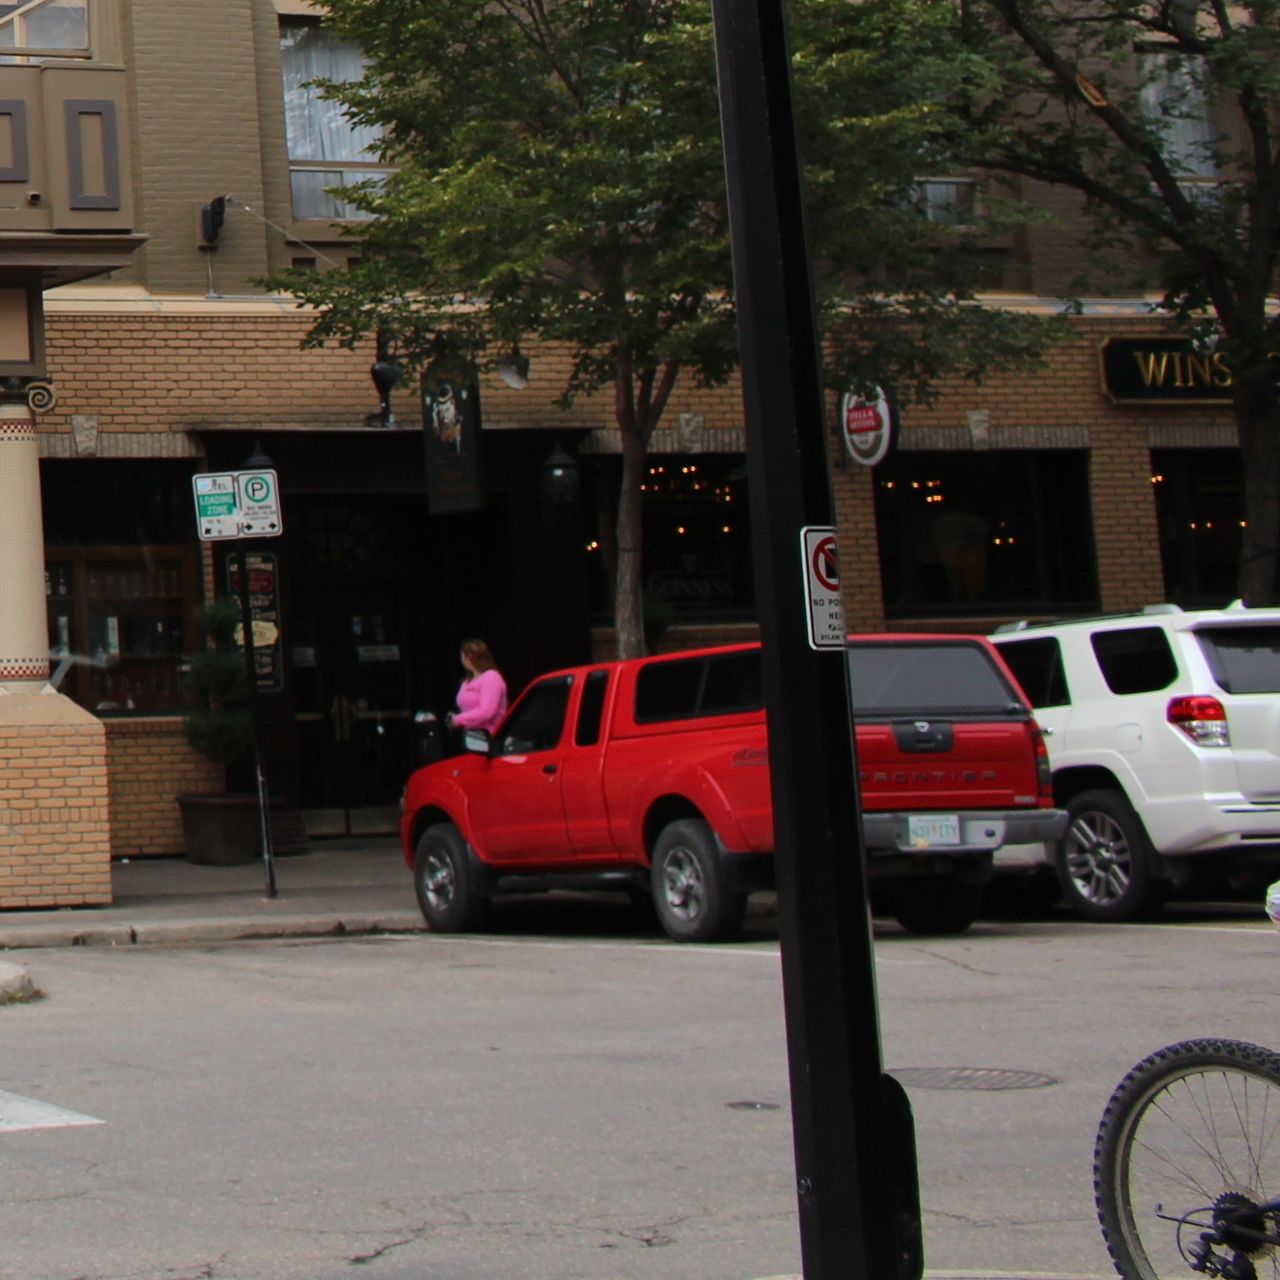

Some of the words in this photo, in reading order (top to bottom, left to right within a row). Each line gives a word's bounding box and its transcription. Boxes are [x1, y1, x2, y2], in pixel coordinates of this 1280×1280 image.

[1133, 350, 1235, 387] WINS
[251, 482, 263, 497] P
[200, 493, 233, 504] LOADING
[207, 505, 229, 515] ZONE
[813, 598, 824, 607] NO
